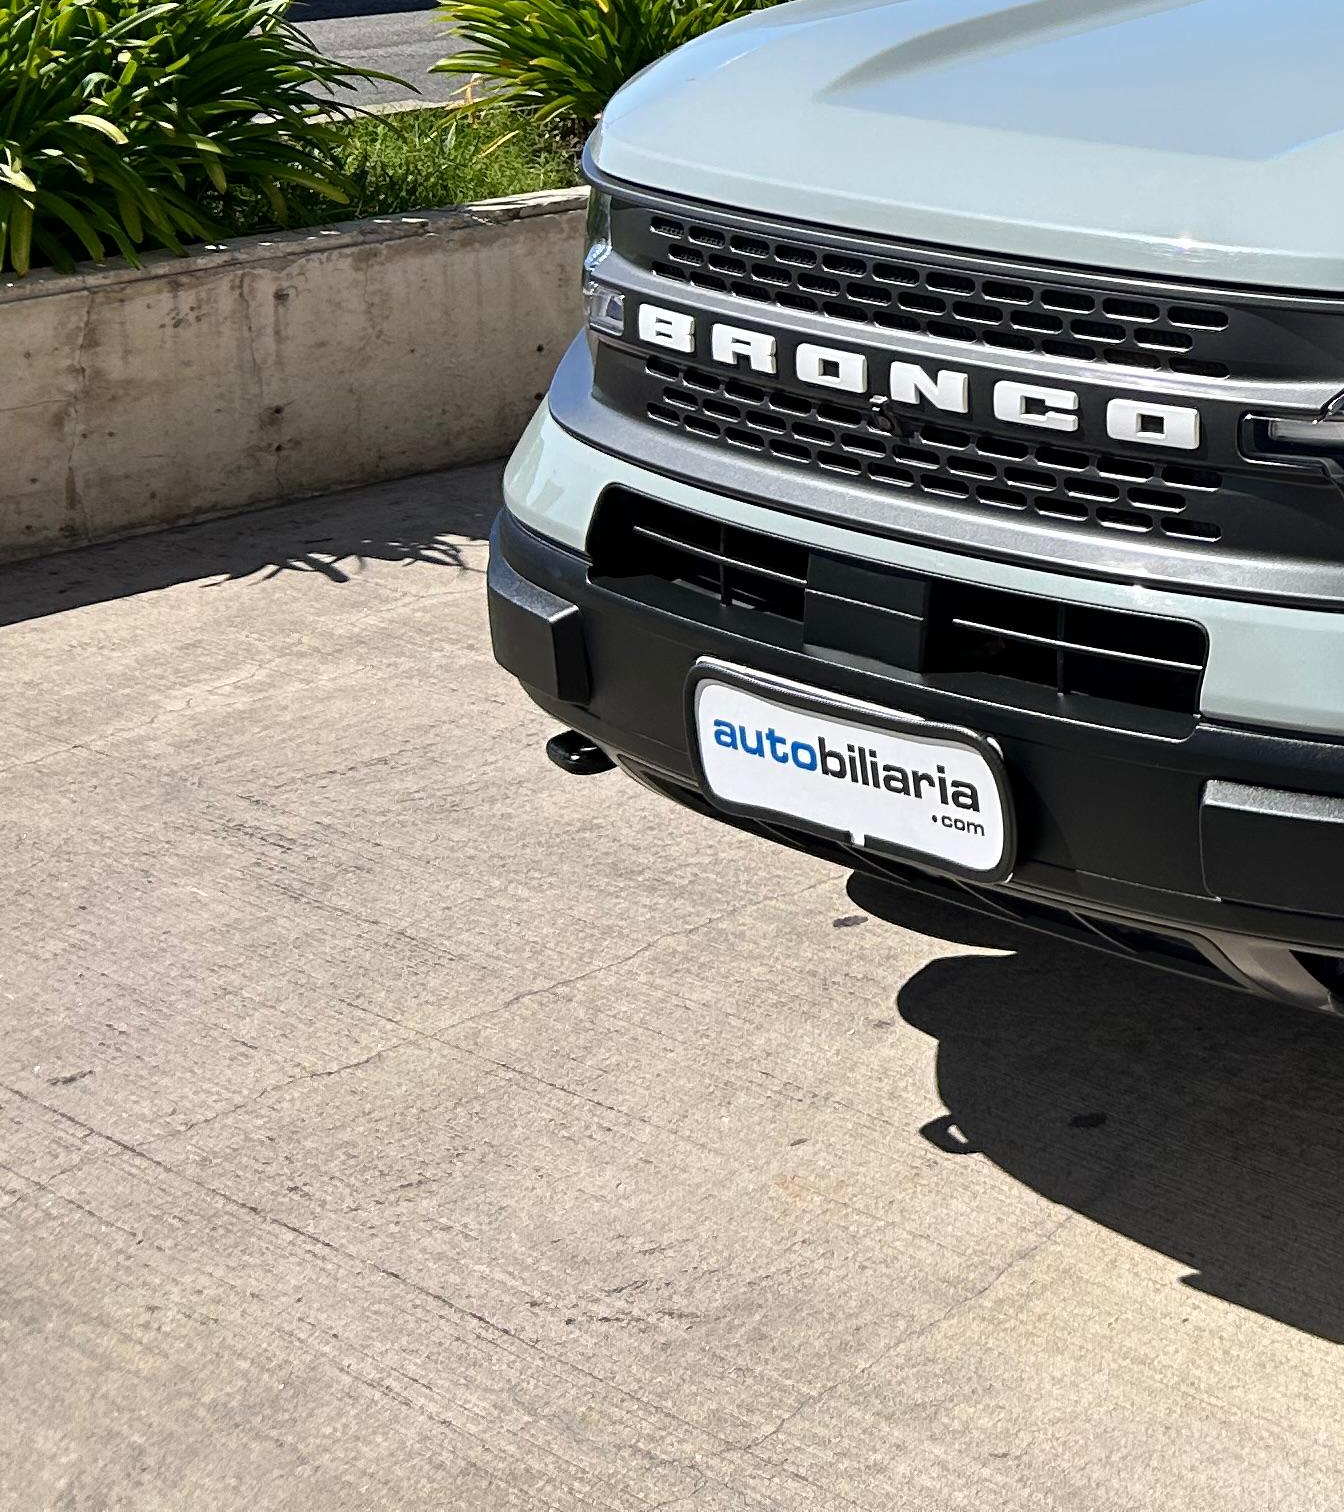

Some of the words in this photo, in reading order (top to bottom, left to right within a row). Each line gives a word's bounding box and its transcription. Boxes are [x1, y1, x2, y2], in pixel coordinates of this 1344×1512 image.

[638, 302, 1200, 450] BRONCO
[712, 718, 981, 813] autobiliaria
[931, 814, 985, 837] .com
